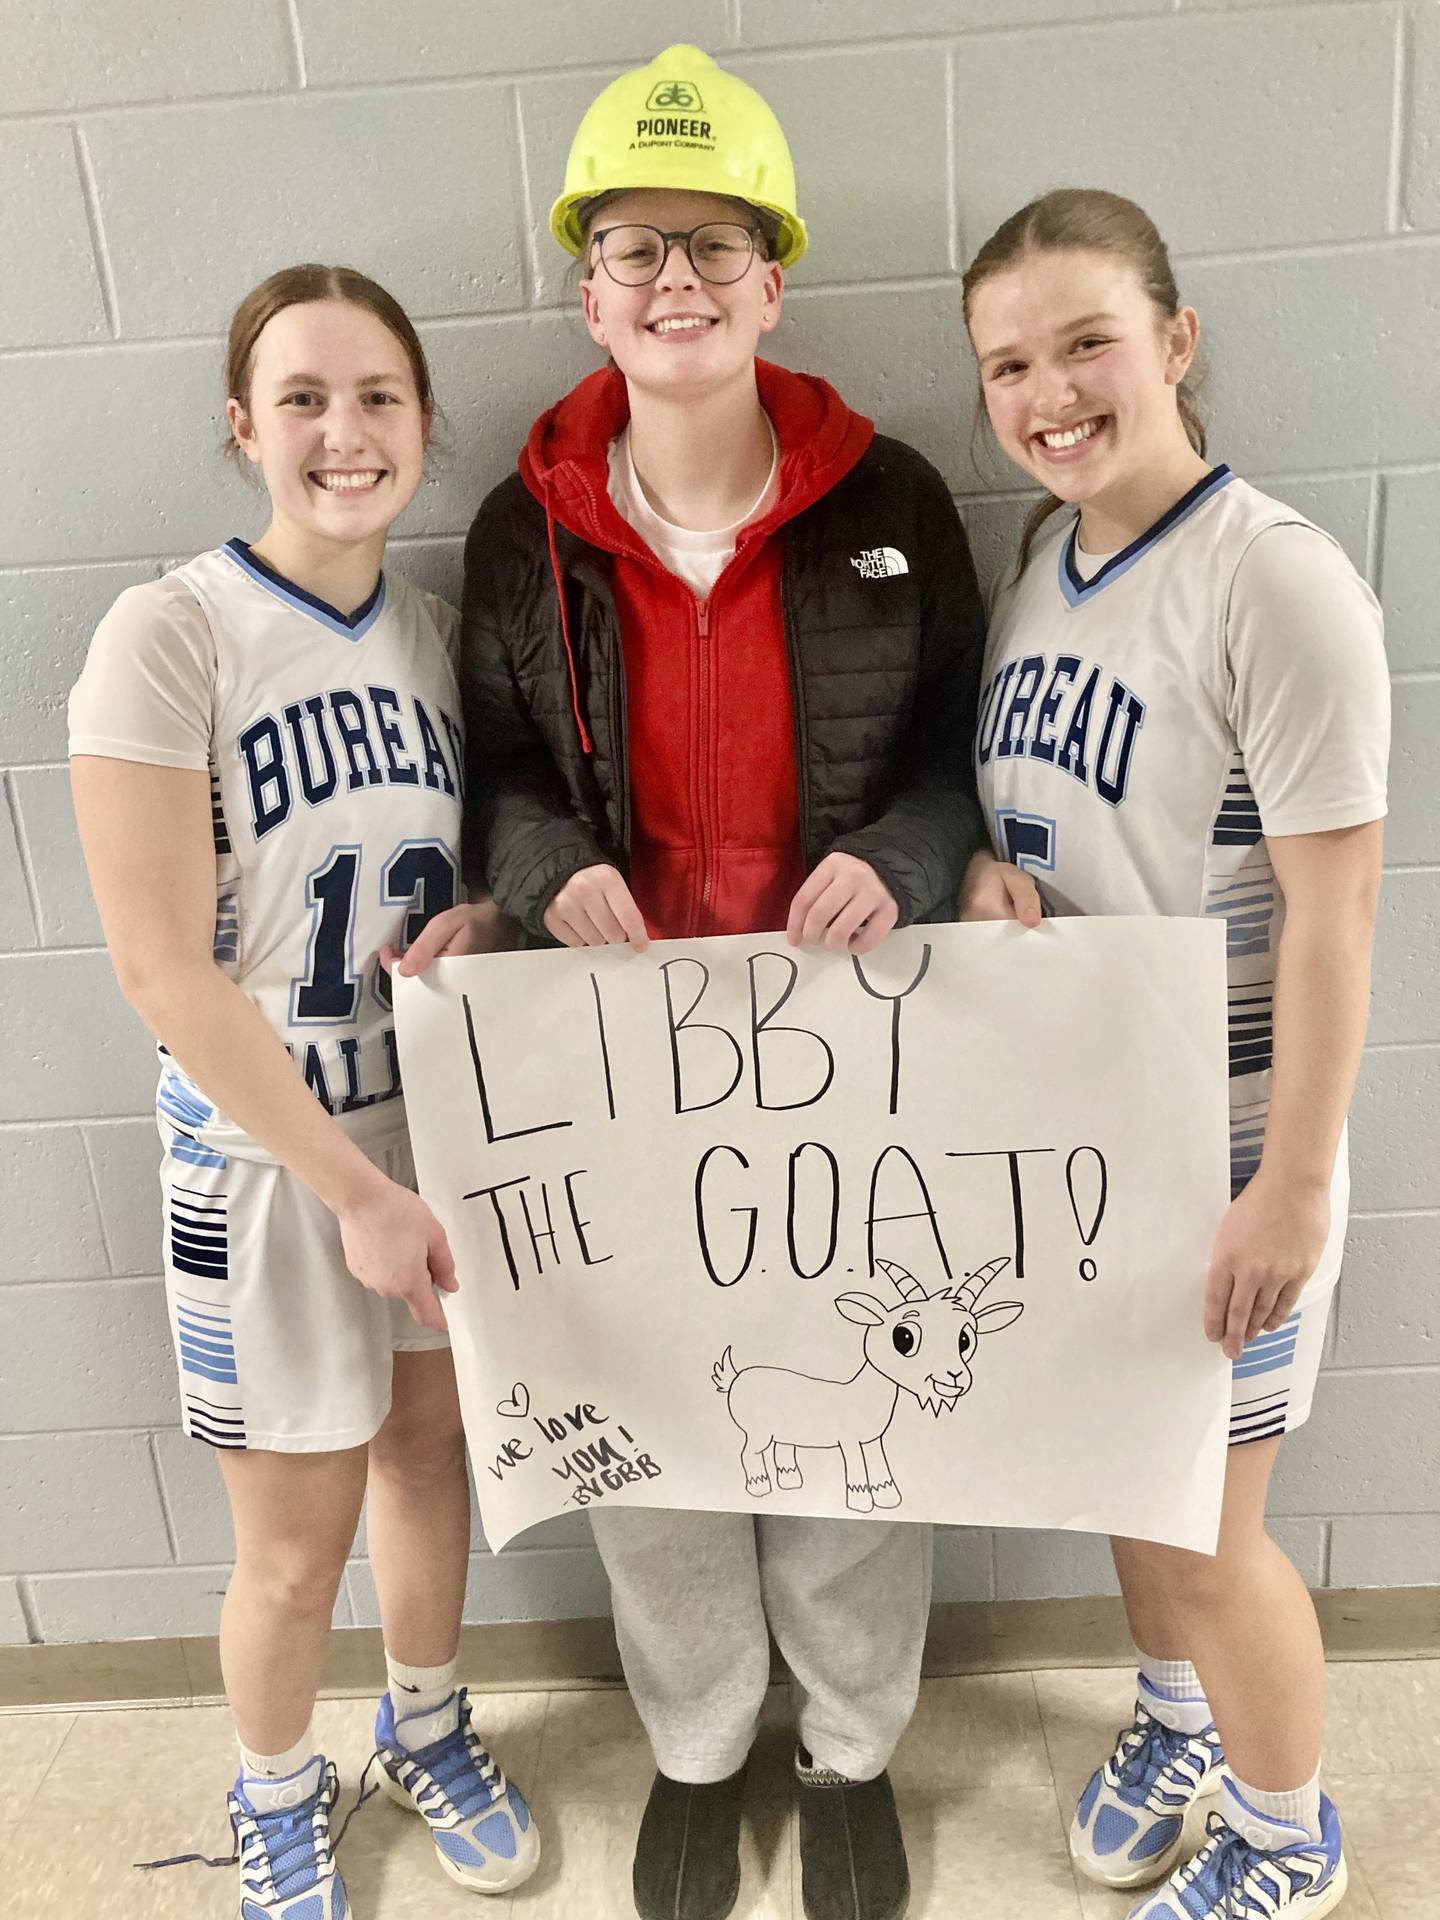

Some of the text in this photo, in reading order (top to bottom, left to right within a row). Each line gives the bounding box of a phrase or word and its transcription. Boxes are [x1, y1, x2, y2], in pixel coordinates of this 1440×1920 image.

[636, 118, 711, 140] PIONEER
[629, 142, 636, 150] A
[859, 547, 883, 561] THE
[860, 567, 888, 579] FACE
[977, 653, 1147, 809] UREAU
[462, 943, 932, 1145] LIBBY
[462, 1169, 615, 1291] THE
[533, 1403, 610, 1444] love
